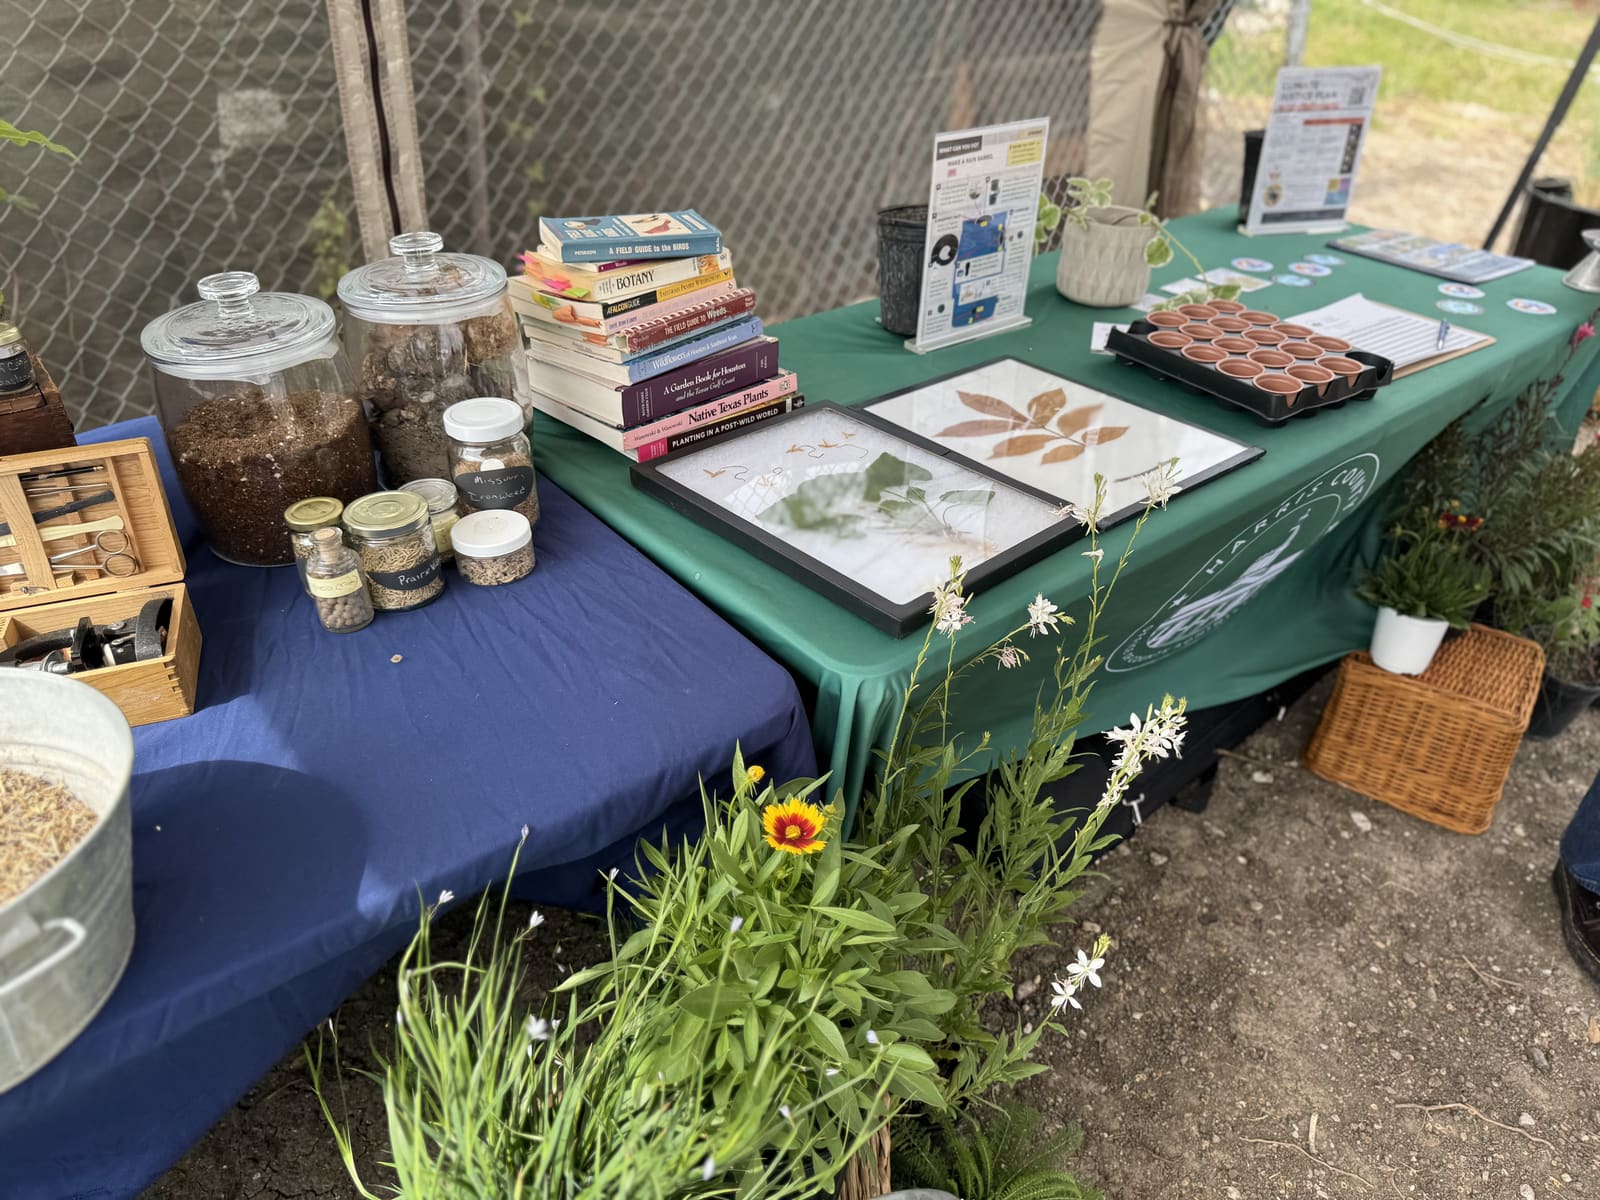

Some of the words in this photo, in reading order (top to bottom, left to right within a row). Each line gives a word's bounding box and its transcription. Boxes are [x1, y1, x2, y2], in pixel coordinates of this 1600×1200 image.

[953, 144, 962, 152] CAN
[947, 158, 960, 167] MAKE
[966, 155, 977, 163] RAIN
[609, 247, 615, 255] A
[616, 246, 633, 254] FIELD
[635, 245, 652, 253] GUIDE
[654, 244, 661, 252] to
[662, 243, 671, 252] the
[617, 270, 655, 290] BOTANY
[664, 325, 674, 336] THE
[674, 321, 687, 334] FIELD
[687, 317, 700, 330] GUIDE
[706, 307, 727, 319] Weeds
[652, 352, 685, 370] Wildflowers
[662, 385, 670, 395] A
[670, 377, 695, 393] Garden
[695, 370, 712, 385] Book
[720, 362, 746, 377] Houston
[675, 392, 686, 402] and
[686, 389, 695, 399] the
[695, 386, 709, 398] Texas
[710, 380, 722, 393] Gulf
[721, 377, 736, 388] Coast
[688, 406, 717, 425] Native
[718, 400, 742, 415] Texas
[743, 389, 769, 406] Plants
[672, 430, 706, 448] PLANTING
[706, 428, 714, 438] IN
[714, 426, 721, 435] A
[721, 414, 755, 432] POST-WILD
[756, 408, 779, 421] WORLD
[1206, 481, 1323, 575] HARRIS
